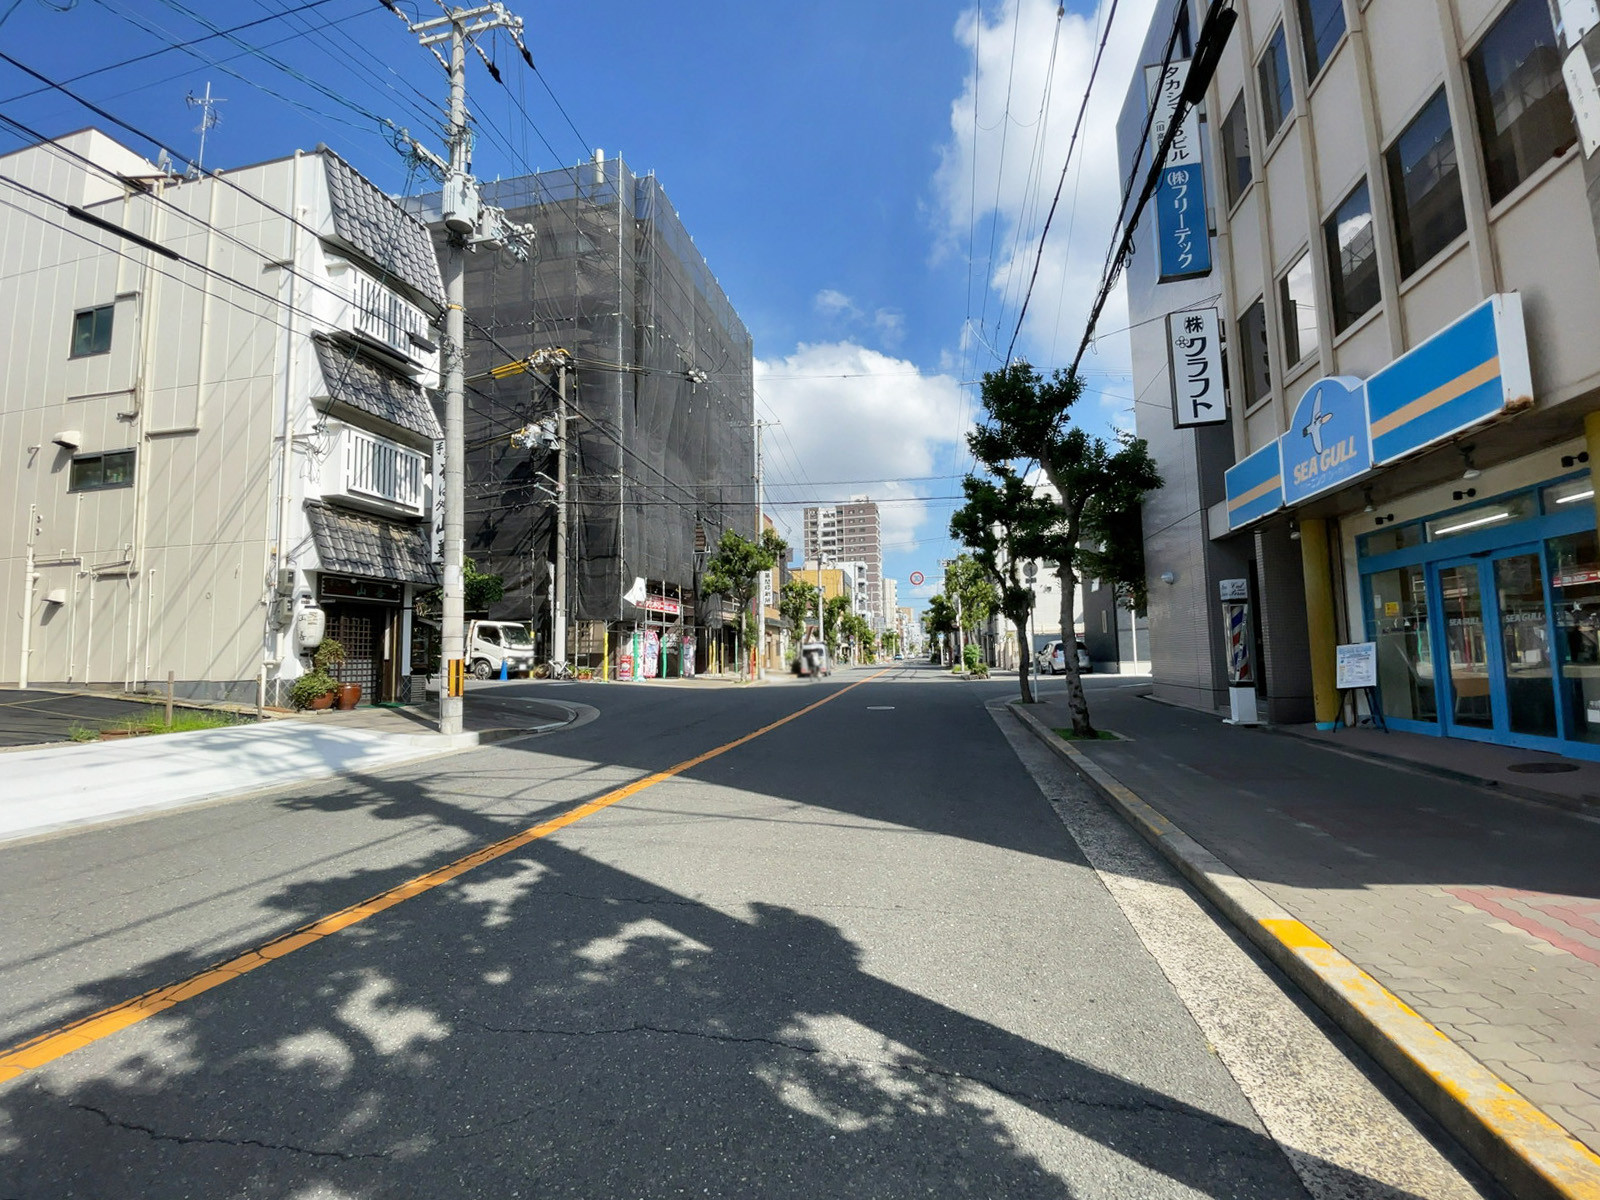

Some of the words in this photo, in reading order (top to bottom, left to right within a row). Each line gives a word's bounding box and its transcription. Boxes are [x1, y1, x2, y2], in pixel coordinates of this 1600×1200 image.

[1293, 455, 1319, 486] SEA
[1320, 435, 1358, 472] GULL
[1505, 614, 1521, 623] SEA
[1521, 612, 1543, 622] GULL
